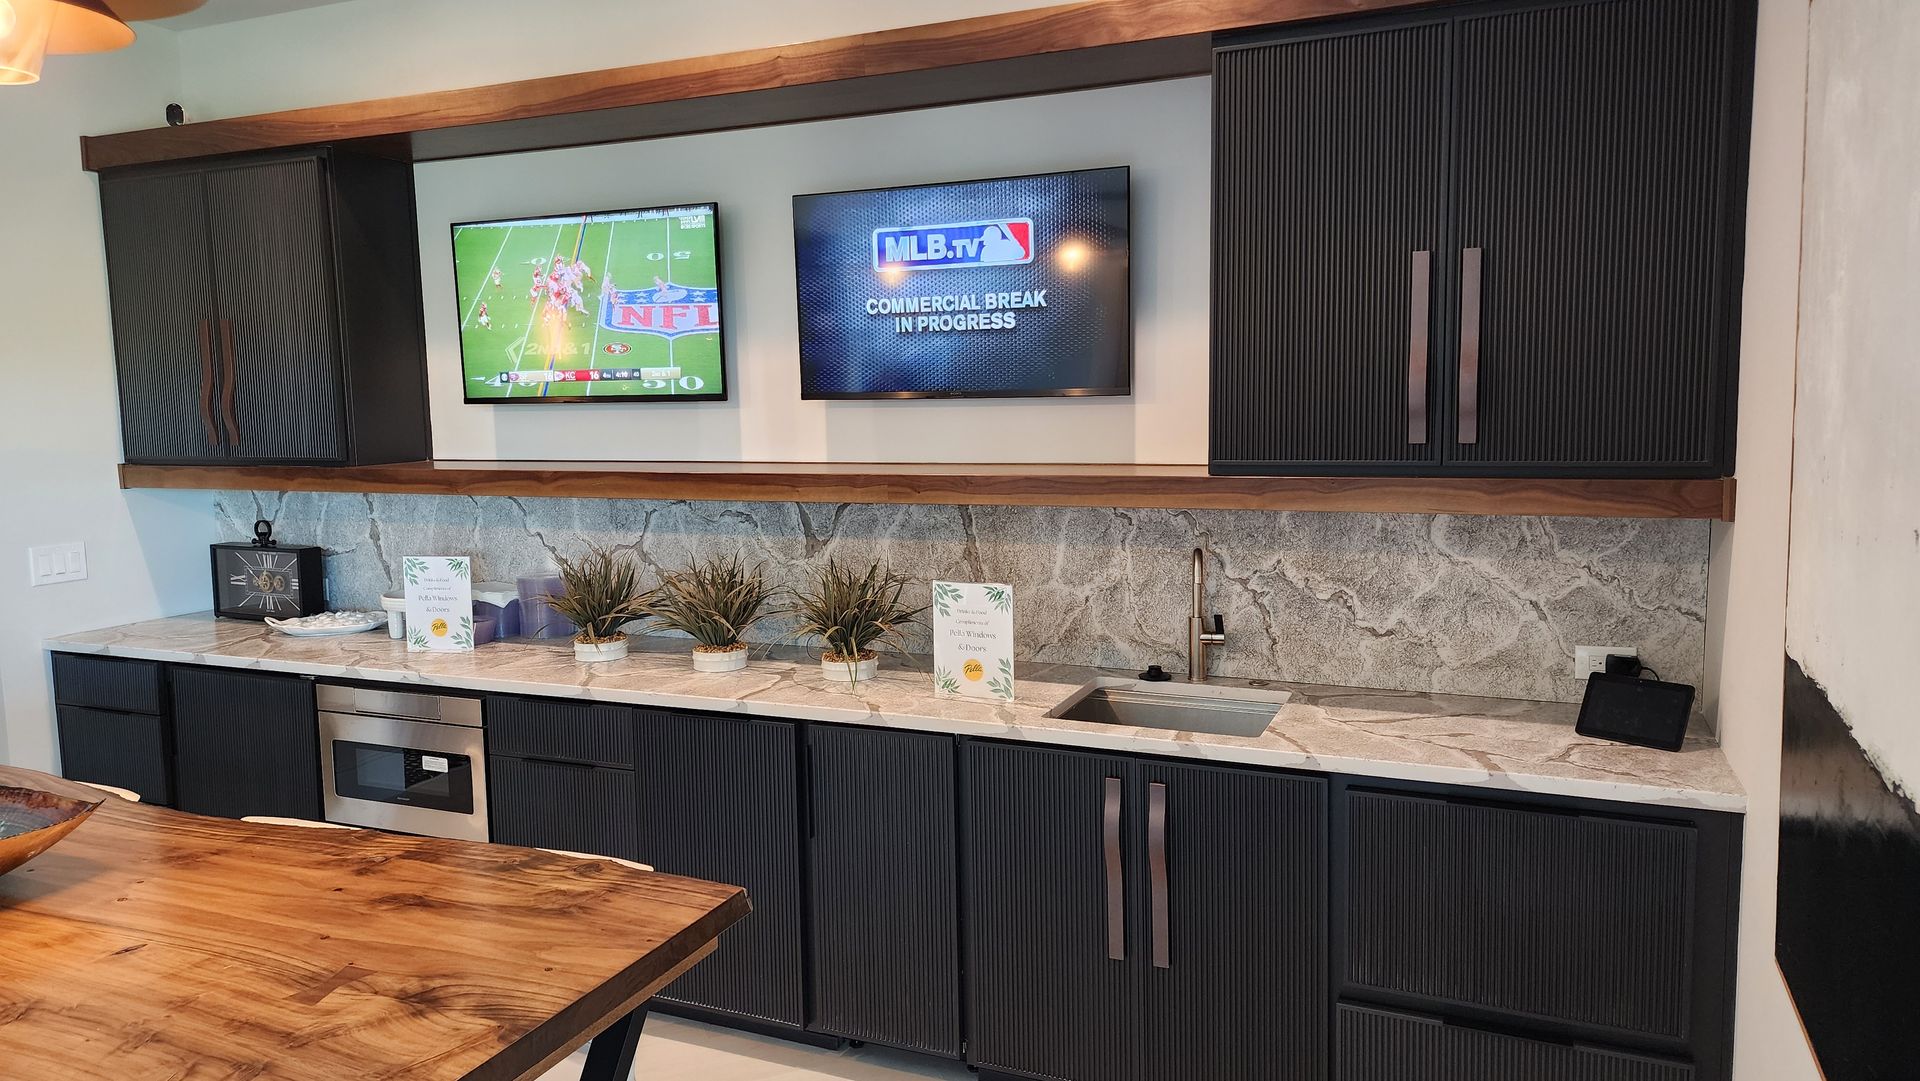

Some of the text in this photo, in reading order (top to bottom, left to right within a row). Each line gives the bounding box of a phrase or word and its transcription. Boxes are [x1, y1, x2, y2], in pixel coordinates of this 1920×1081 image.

[866, 290, 1047, 315] COMMERCIAL BREAK
[619, 305, 718, 328] NFL
[895, 312, 1016, 333] IN PROGRESS
[565, 371, 600, 380] KC 16
[949, 629, 996, 639] Pella Windows
[965, 644, 986, 652] Doors
